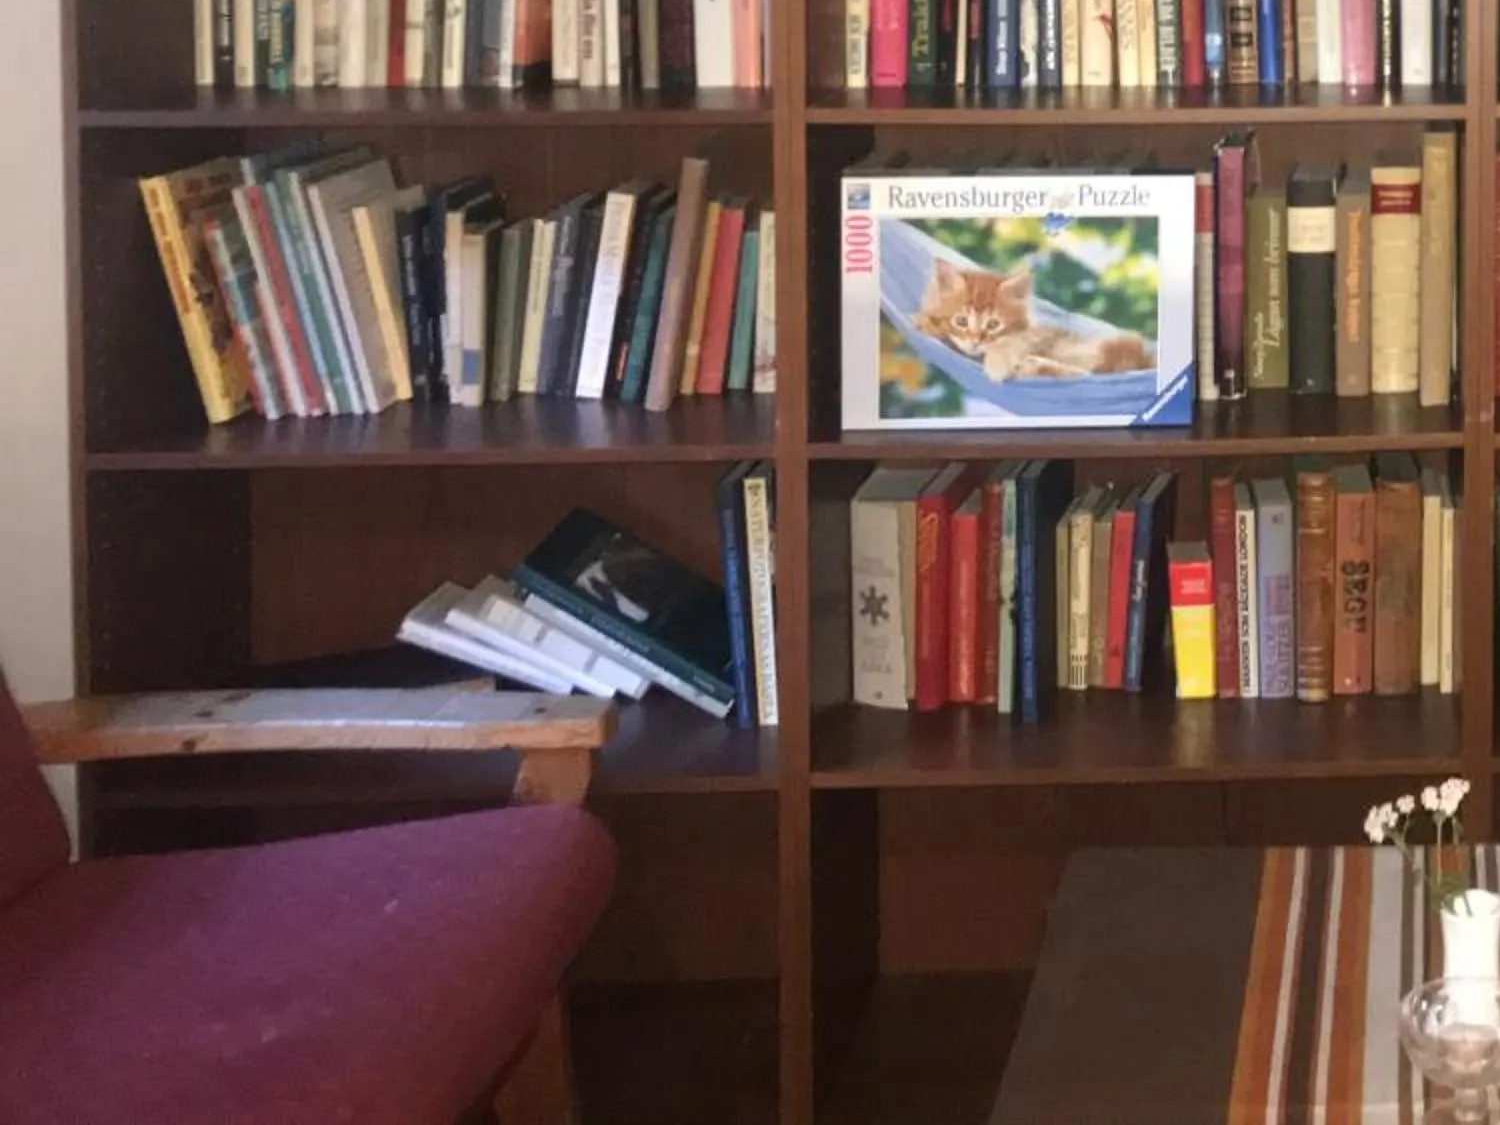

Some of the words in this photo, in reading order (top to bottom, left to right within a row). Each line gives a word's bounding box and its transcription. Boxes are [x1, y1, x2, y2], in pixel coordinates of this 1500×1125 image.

[887, 184, 1048, 214] Ravensburger
[1077, 183, 1151, 208] Puzzle
[845, 214, 874, 274] 1000
